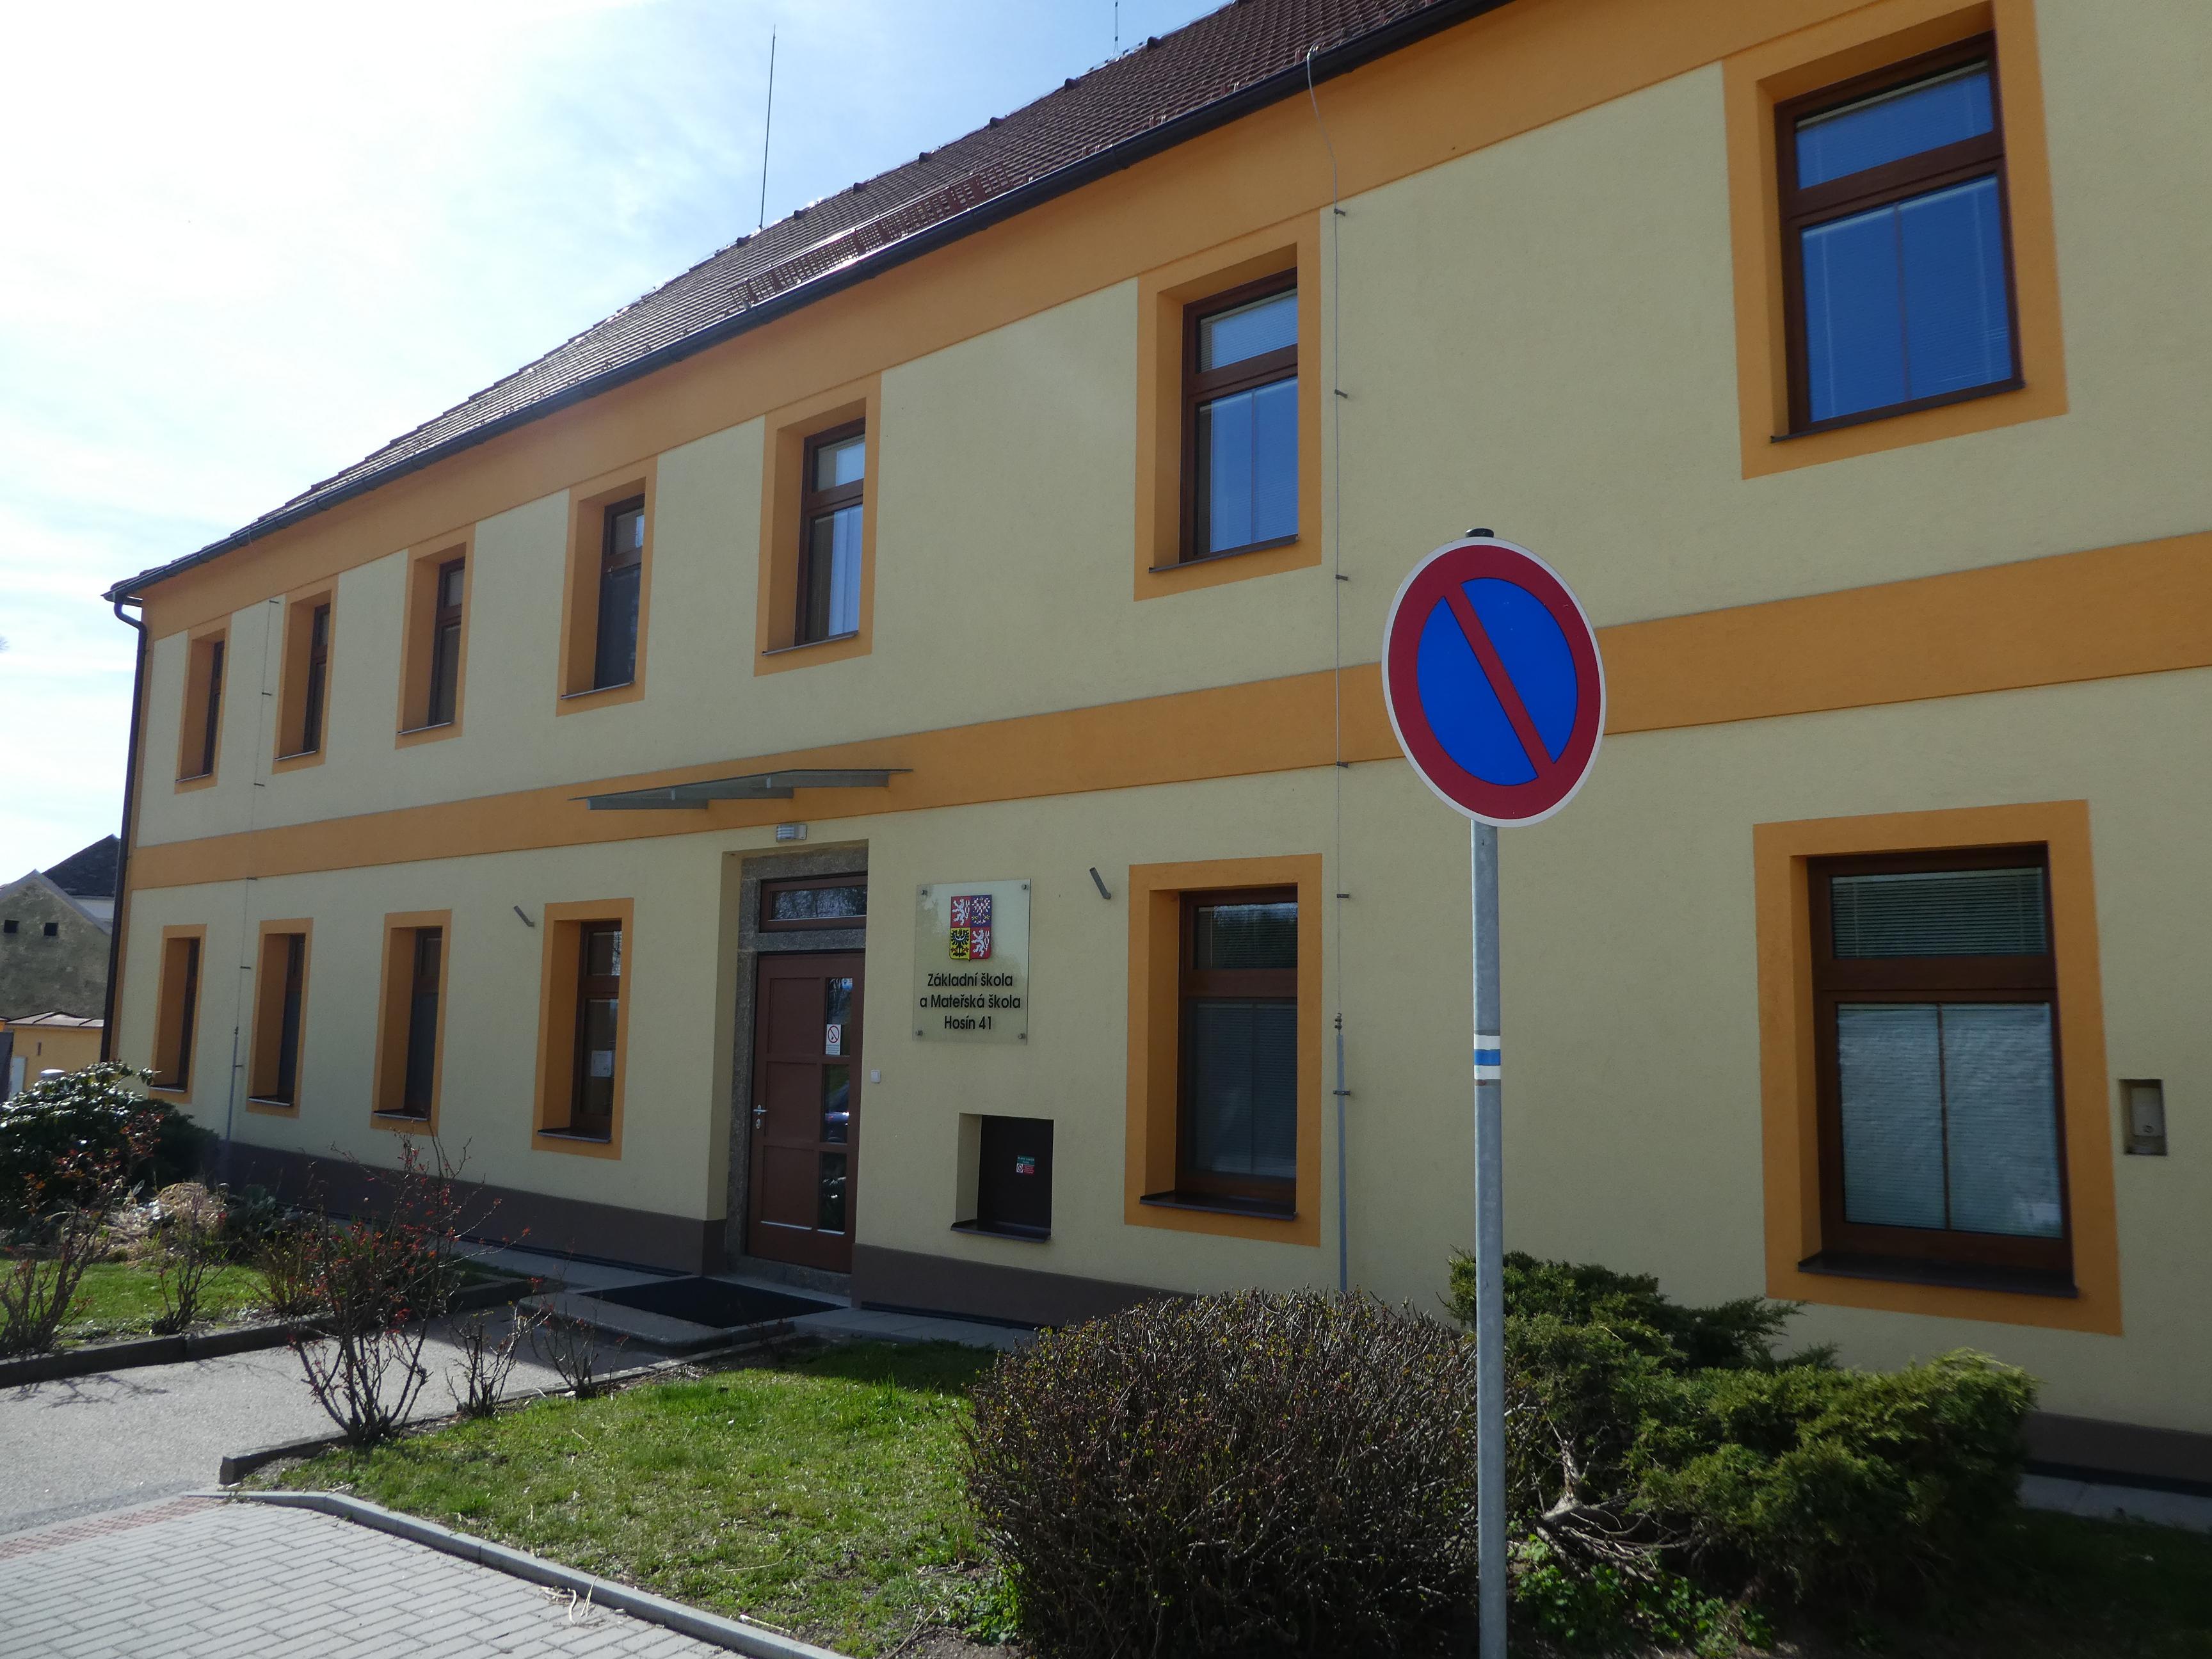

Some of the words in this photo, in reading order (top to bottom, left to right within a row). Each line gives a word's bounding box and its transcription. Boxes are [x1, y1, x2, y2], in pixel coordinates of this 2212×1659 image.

[928, 972, 978, 987] Základní
[981, 972, 1013, 987] škola
[920, 997, 927, 1008] a
[931, 993, 984, 1008] Mateřská
[988, 993, 1020, 1009] škola
[944, 1014, 975, 1029] Hosín
[979, 1016, 991, 1030] 41
